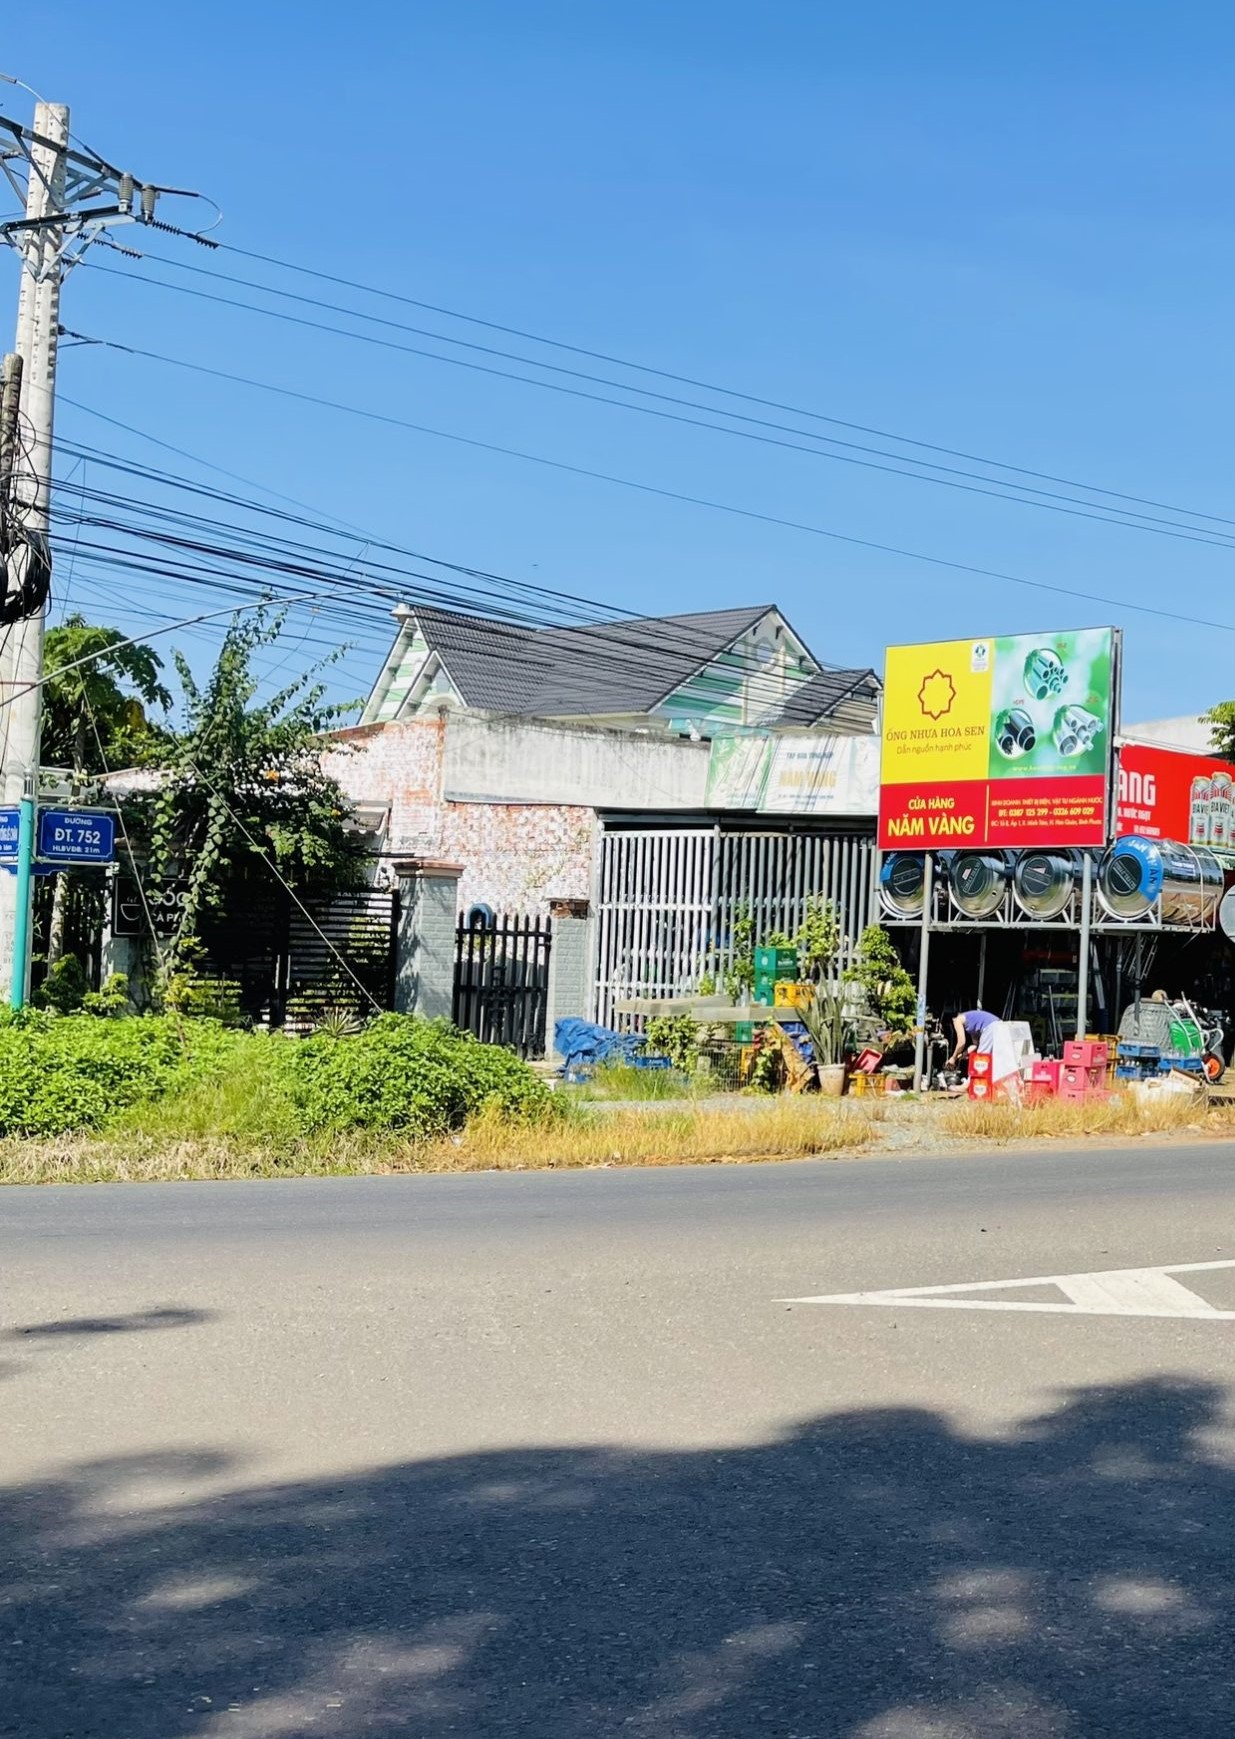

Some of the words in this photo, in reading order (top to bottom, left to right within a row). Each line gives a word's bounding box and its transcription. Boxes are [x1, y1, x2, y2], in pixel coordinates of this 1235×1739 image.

[886, 728, 907, 741] ỐNG
[941, 727, 962, 738] HOA
[965, 726, 985, 737] SEN
[908, 796, 926, 810] CỬA
[928, 796, 955, 809] HÀNG
[64, 817, 93, 826] ĐƯỜNG
[888, 813, 925, 837] NĂM
[928, 812, 975, 835] VÀNG
[55, 828, 74, 842] ĐT.
[77, 829, 101, 844] 752
